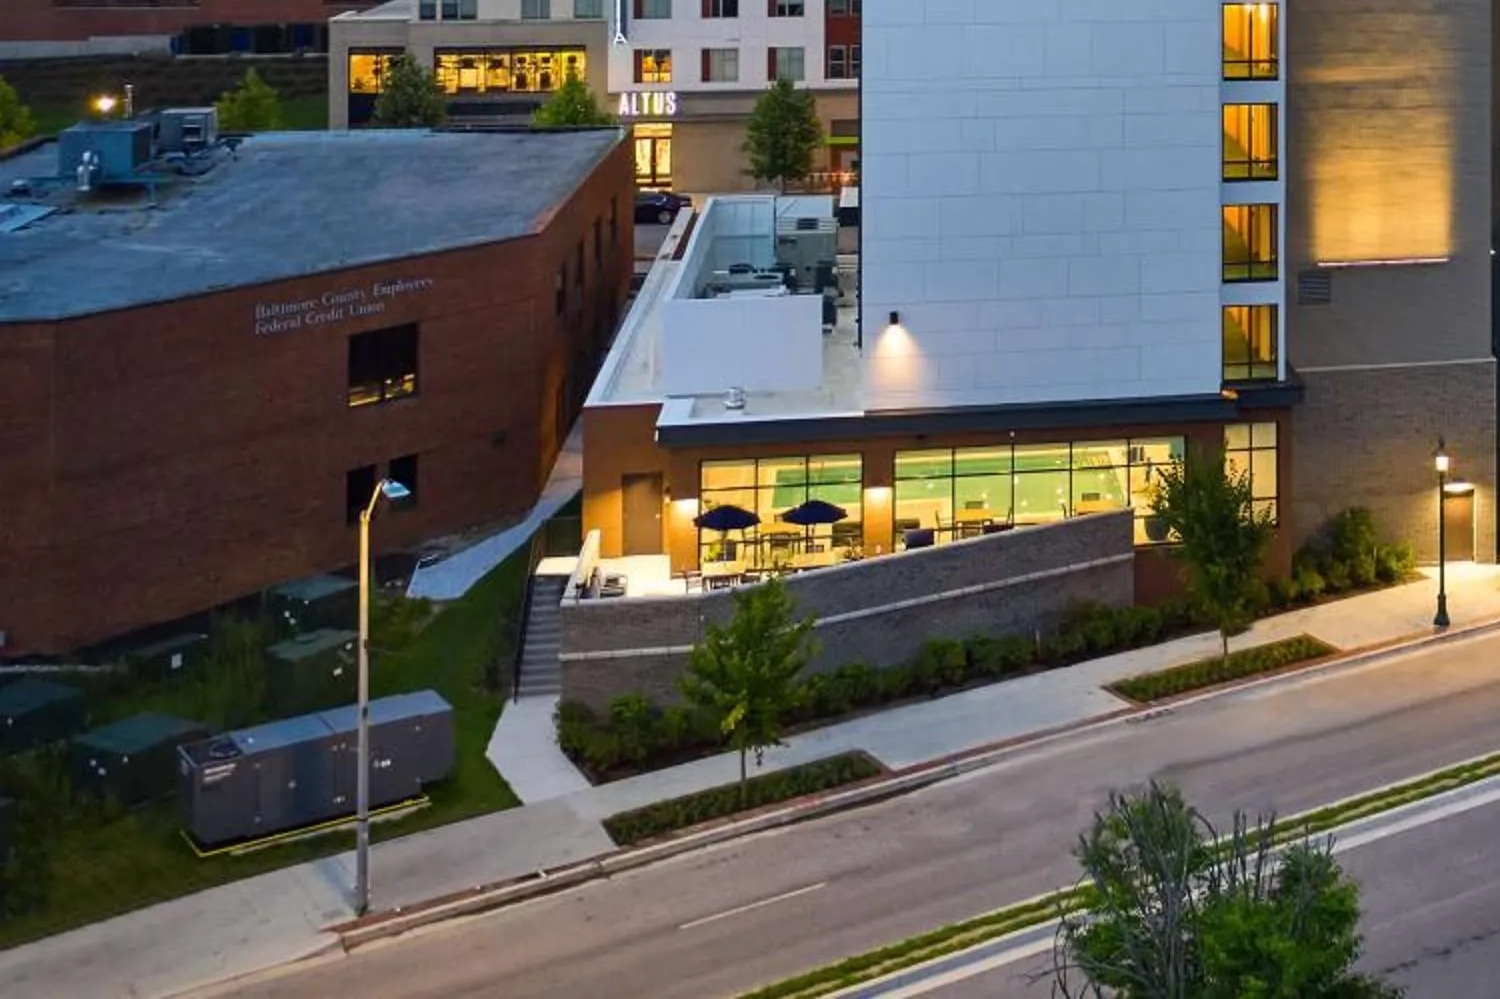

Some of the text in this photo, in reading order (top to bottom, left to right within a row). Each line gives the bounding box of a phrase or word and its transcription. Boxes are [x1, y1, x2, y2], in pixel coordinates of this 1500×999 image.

[619, 92, 677, 115] ALTUS
[255, 302, 386, 335] Federal Credit Union
